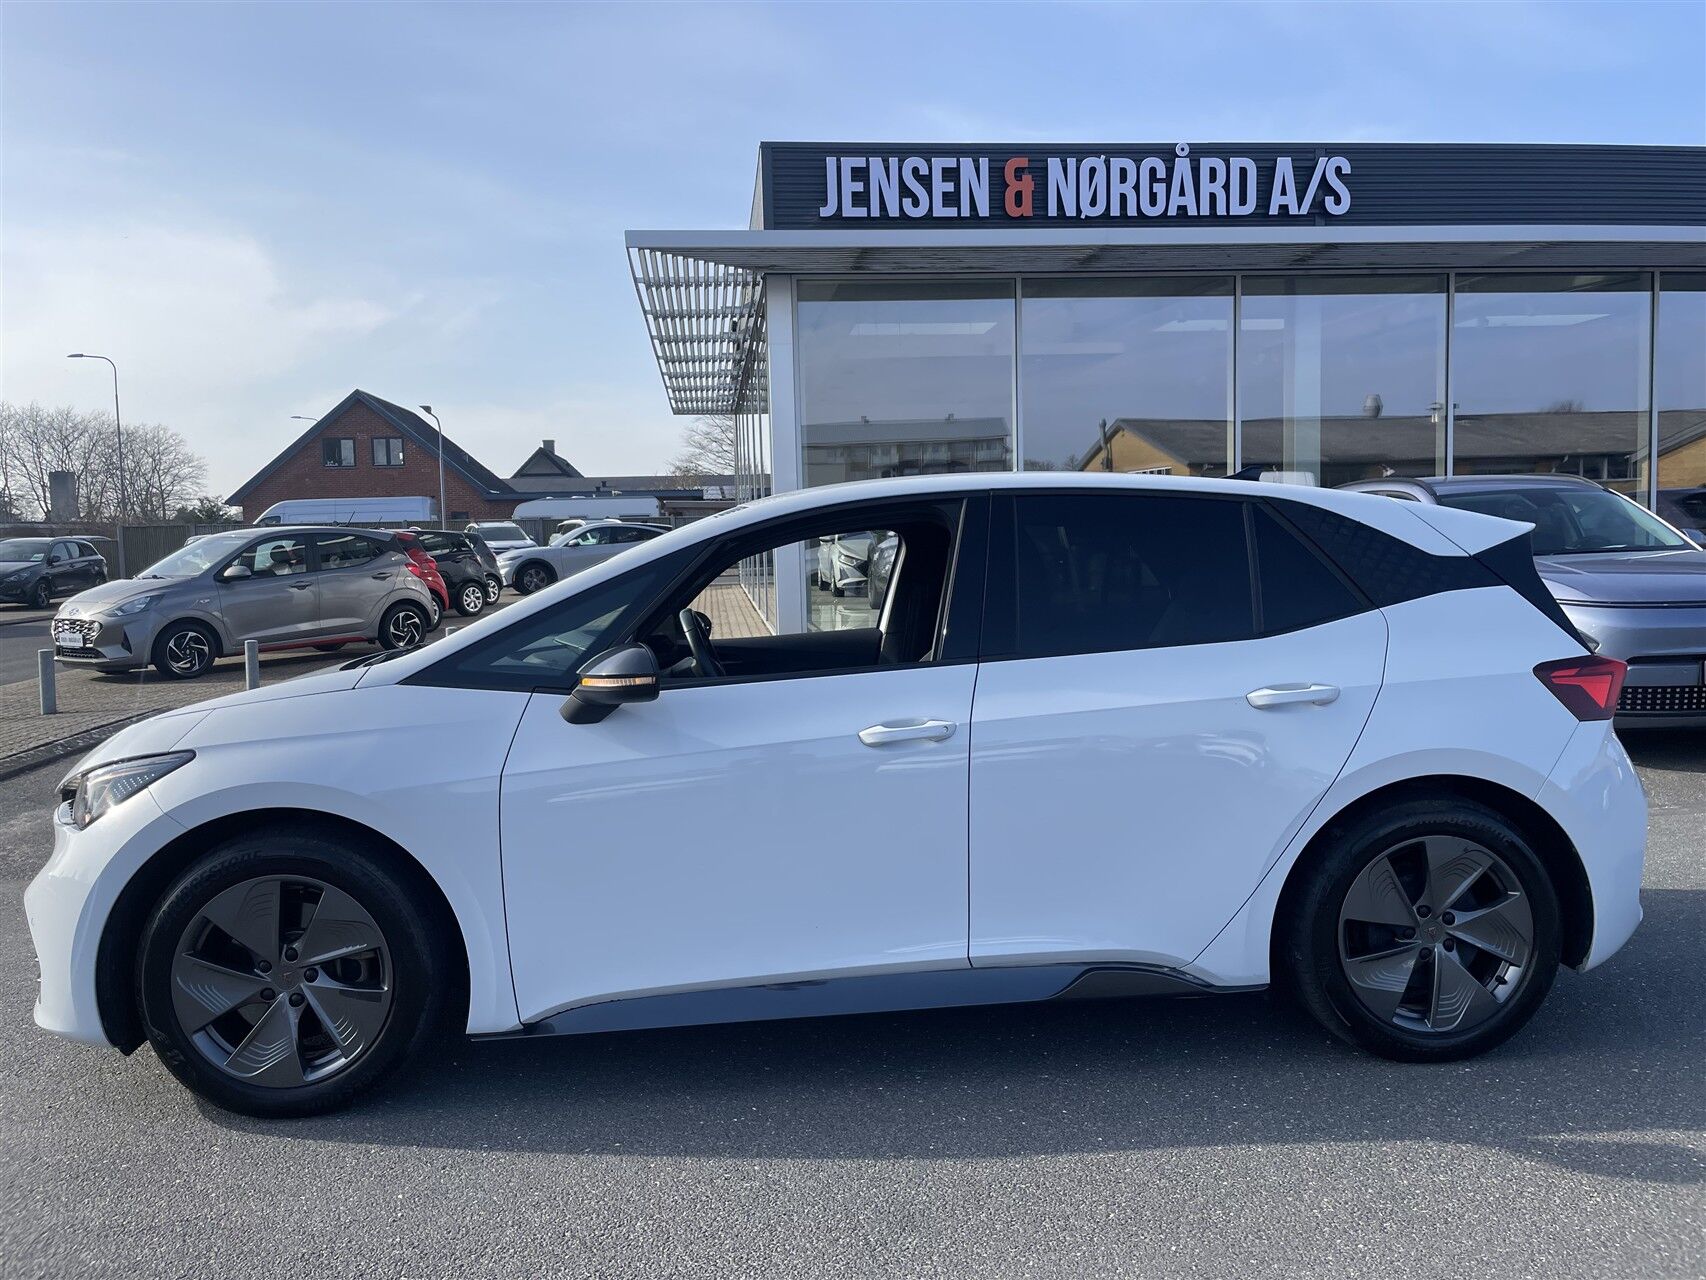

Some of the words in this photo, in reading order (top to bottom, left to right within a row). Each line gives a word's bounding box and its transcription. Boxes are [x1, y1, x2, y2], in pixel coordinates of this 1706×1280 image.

[819, 156, 990, 218] JENSEN
[1004, 157, 1034, 217] &
[1047, 142, 1257, 219] NØRGÅRD
[1269, 156, 1352, 216] A/S
